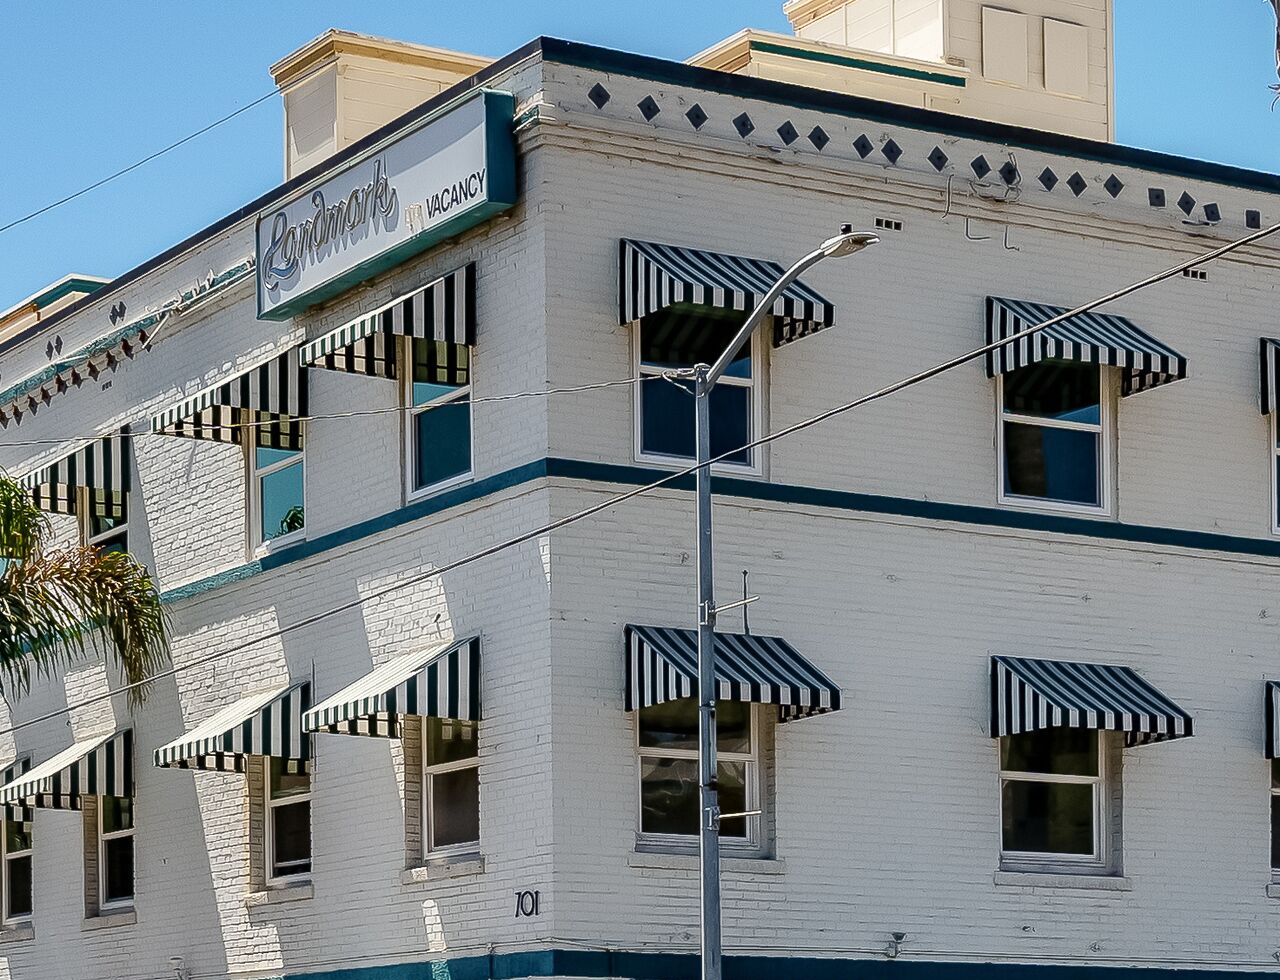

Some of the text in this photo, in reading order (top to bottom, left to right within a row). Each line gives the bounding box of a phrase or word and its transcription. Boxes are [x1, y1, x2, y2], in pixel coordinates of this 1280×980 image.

[426, 168, 486, 219] VACANCY
[263, 159, 397, 291] Landmark
[515, 890, 541, 918] 701
